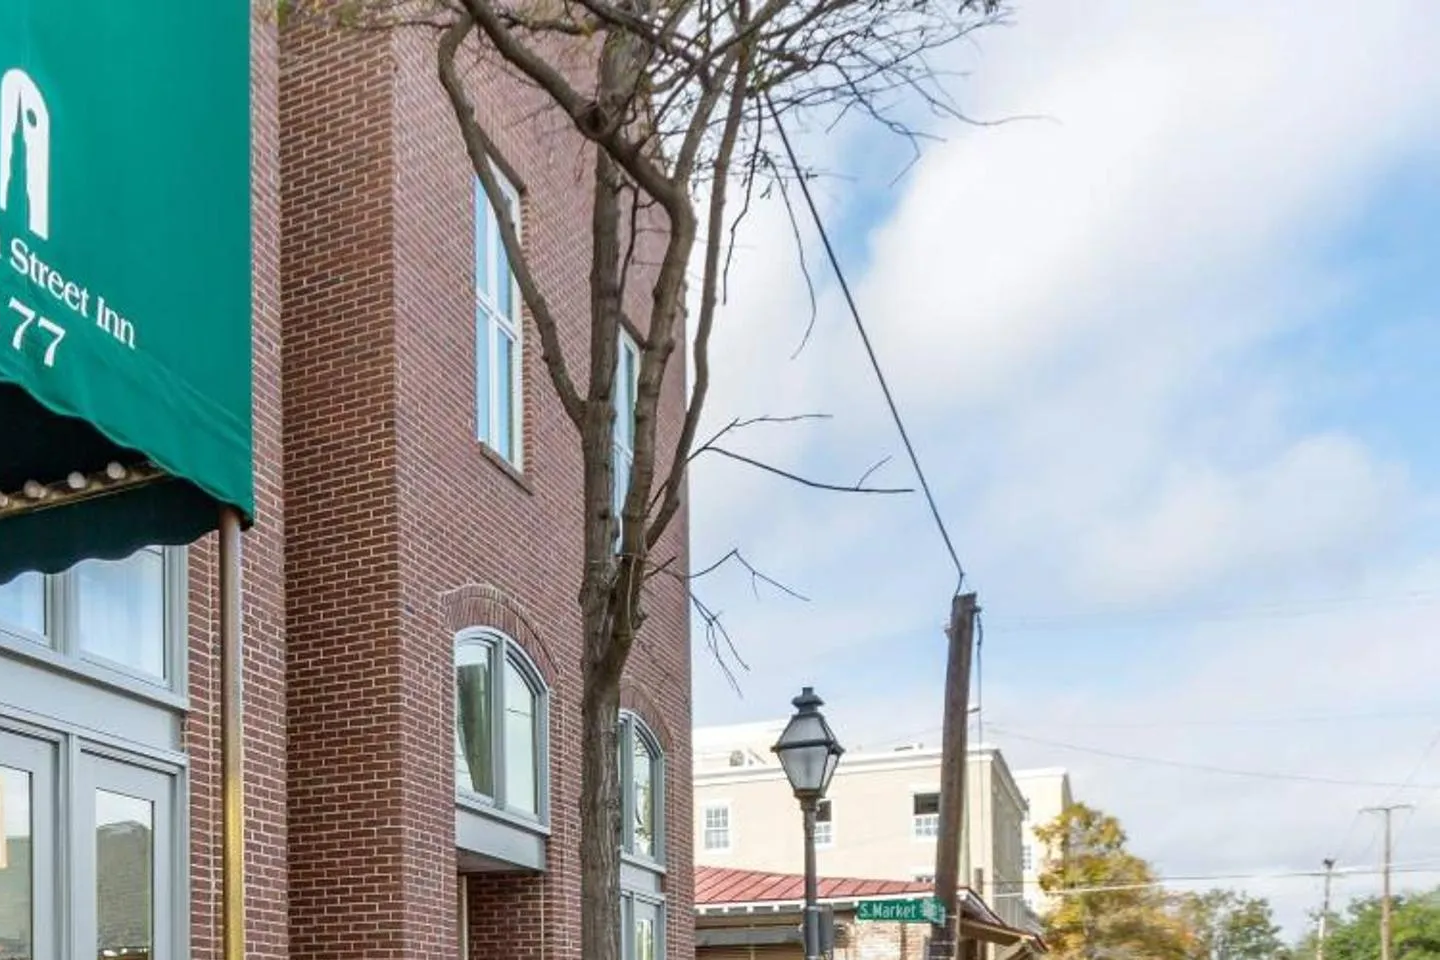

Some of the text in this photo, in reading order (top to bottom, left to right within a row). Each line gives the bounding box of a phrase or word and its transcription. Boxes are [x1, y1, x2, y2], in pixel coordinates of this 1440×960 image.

[10, 238, 89, 318] Street
[97, 297, 135, 349] Inn
[873, 902, 916, 918] Market
